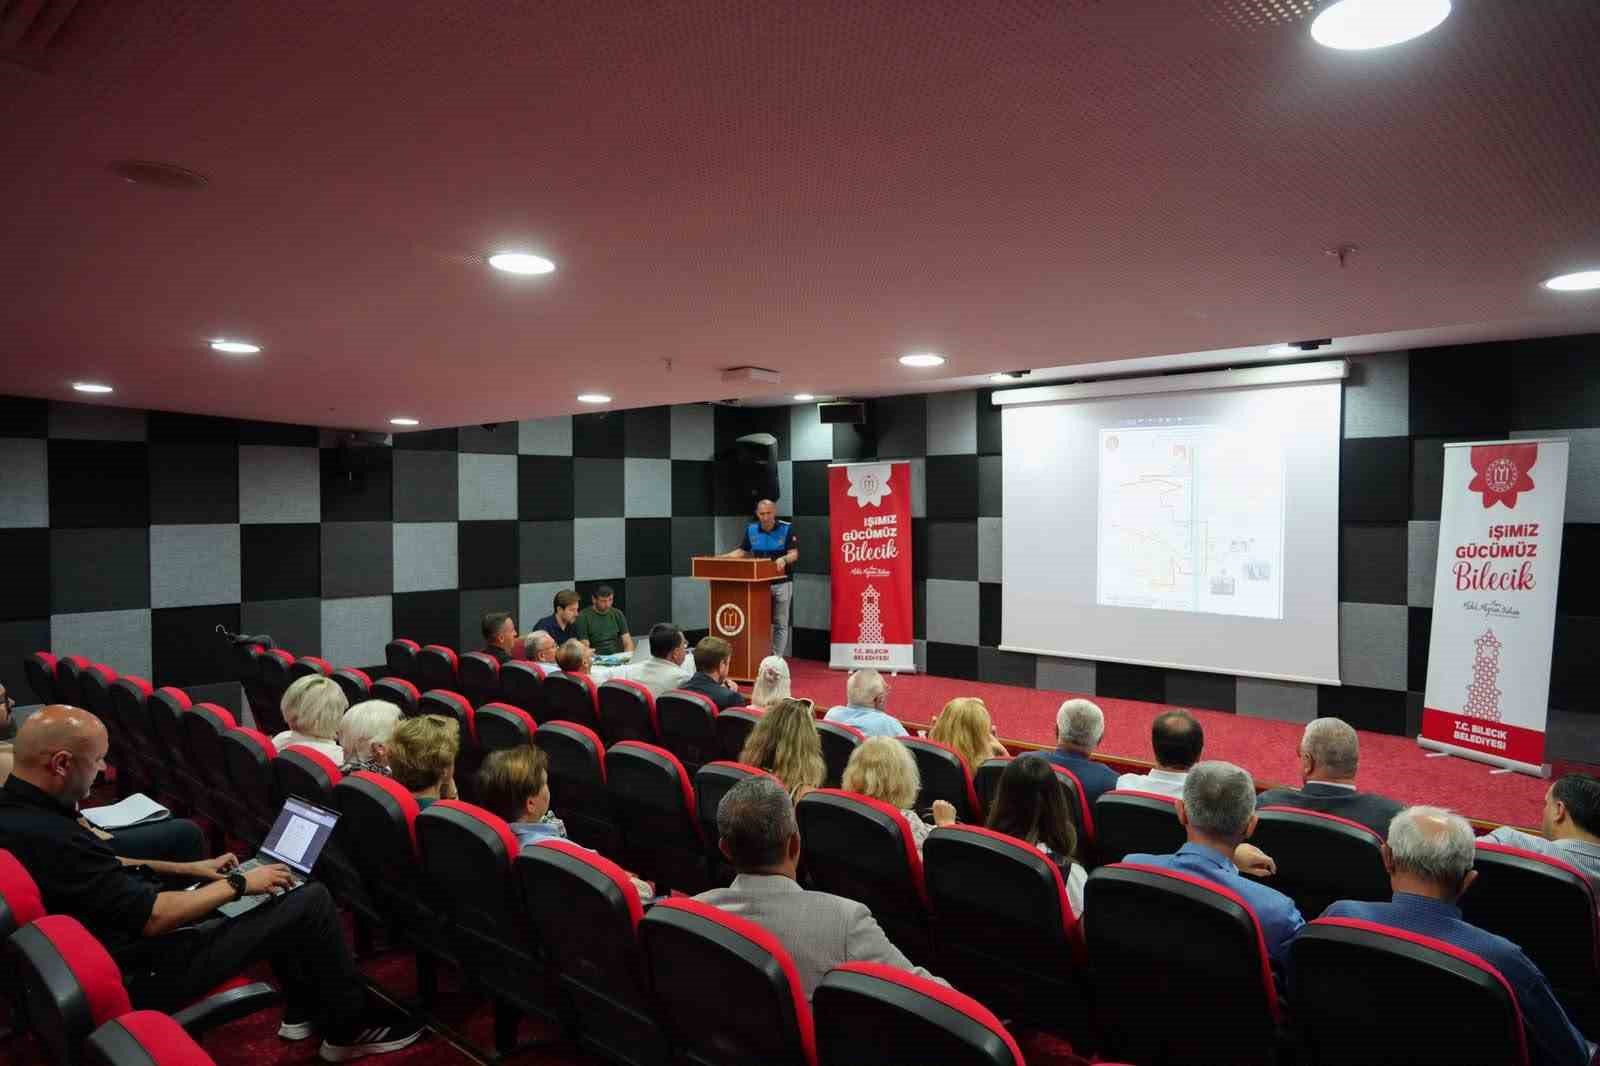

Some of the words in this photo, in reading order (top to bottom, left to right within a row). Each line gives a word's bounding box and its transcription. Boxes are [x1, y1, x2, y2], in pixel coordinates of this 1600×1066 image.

[843, 527, 898, 541] GÜCÜMÜZ
[1488, 523, 1538, 540] İŞİMİZ
[841, 538, 899, 563] Bilecik
[1456, 541, 1537, 558] GÜCÜMÜZ
[1452, 560, 1536, 592] Bilecik
